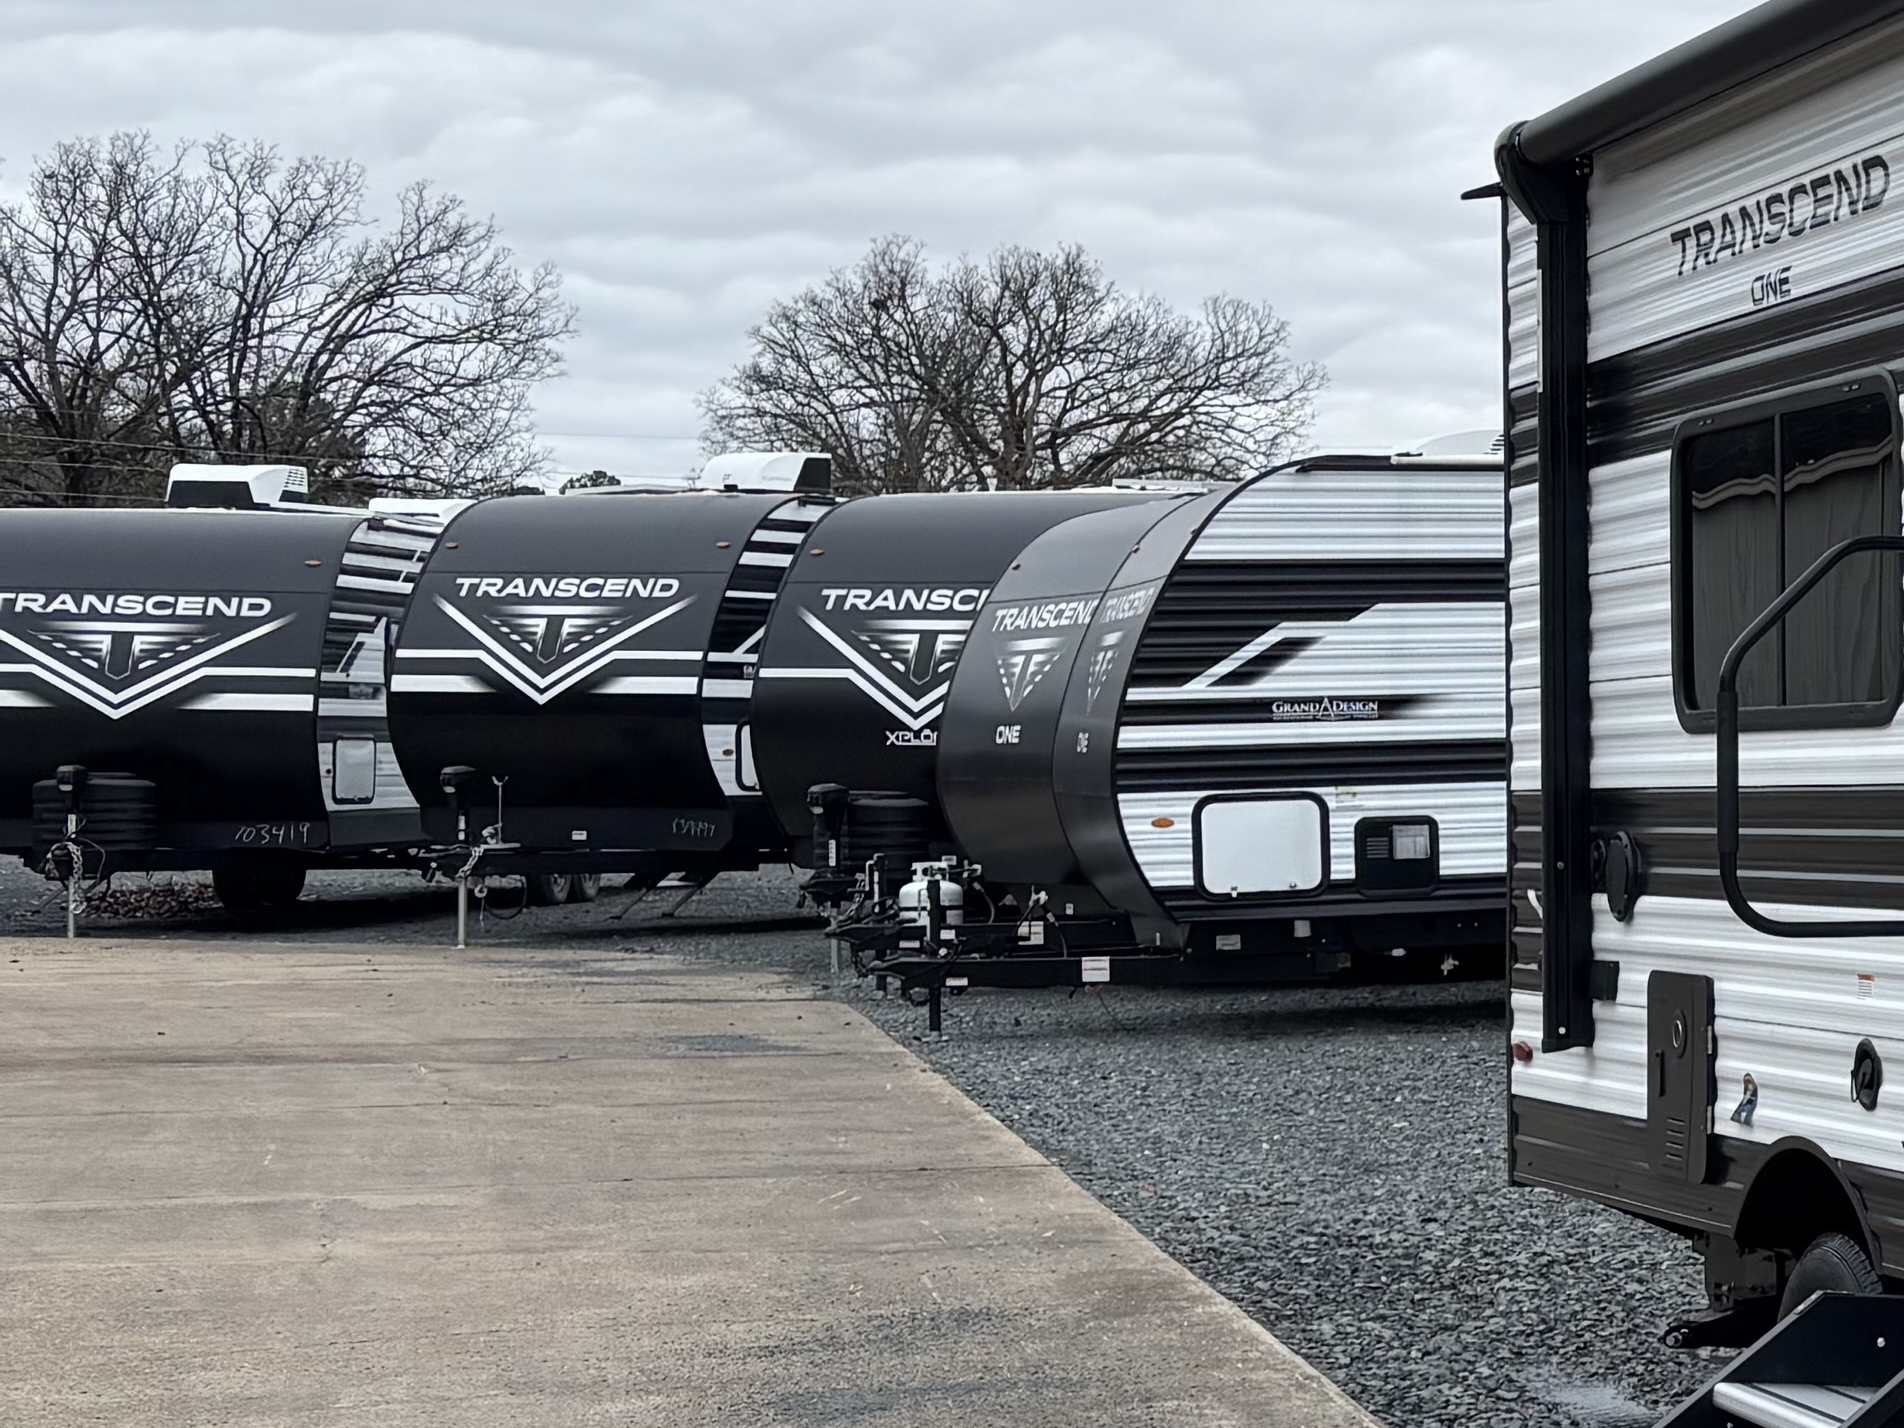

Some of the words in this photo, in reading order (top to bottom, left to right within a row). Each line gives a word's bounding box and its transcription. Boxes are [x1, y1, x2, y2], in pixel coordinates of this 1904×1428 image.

[1670, 155, 1890, 276] TRANSCEND
[1751, 265, 1793, 307] ONE
[455, 577, 680, 599] TRANSCEND
[1271, 701, 1320, 714] GRAND
[1332, 700, 1378, 713] DESIGN
[995, 724, 1021, 745] ONE
[234, 821, 311, 845] 103419
